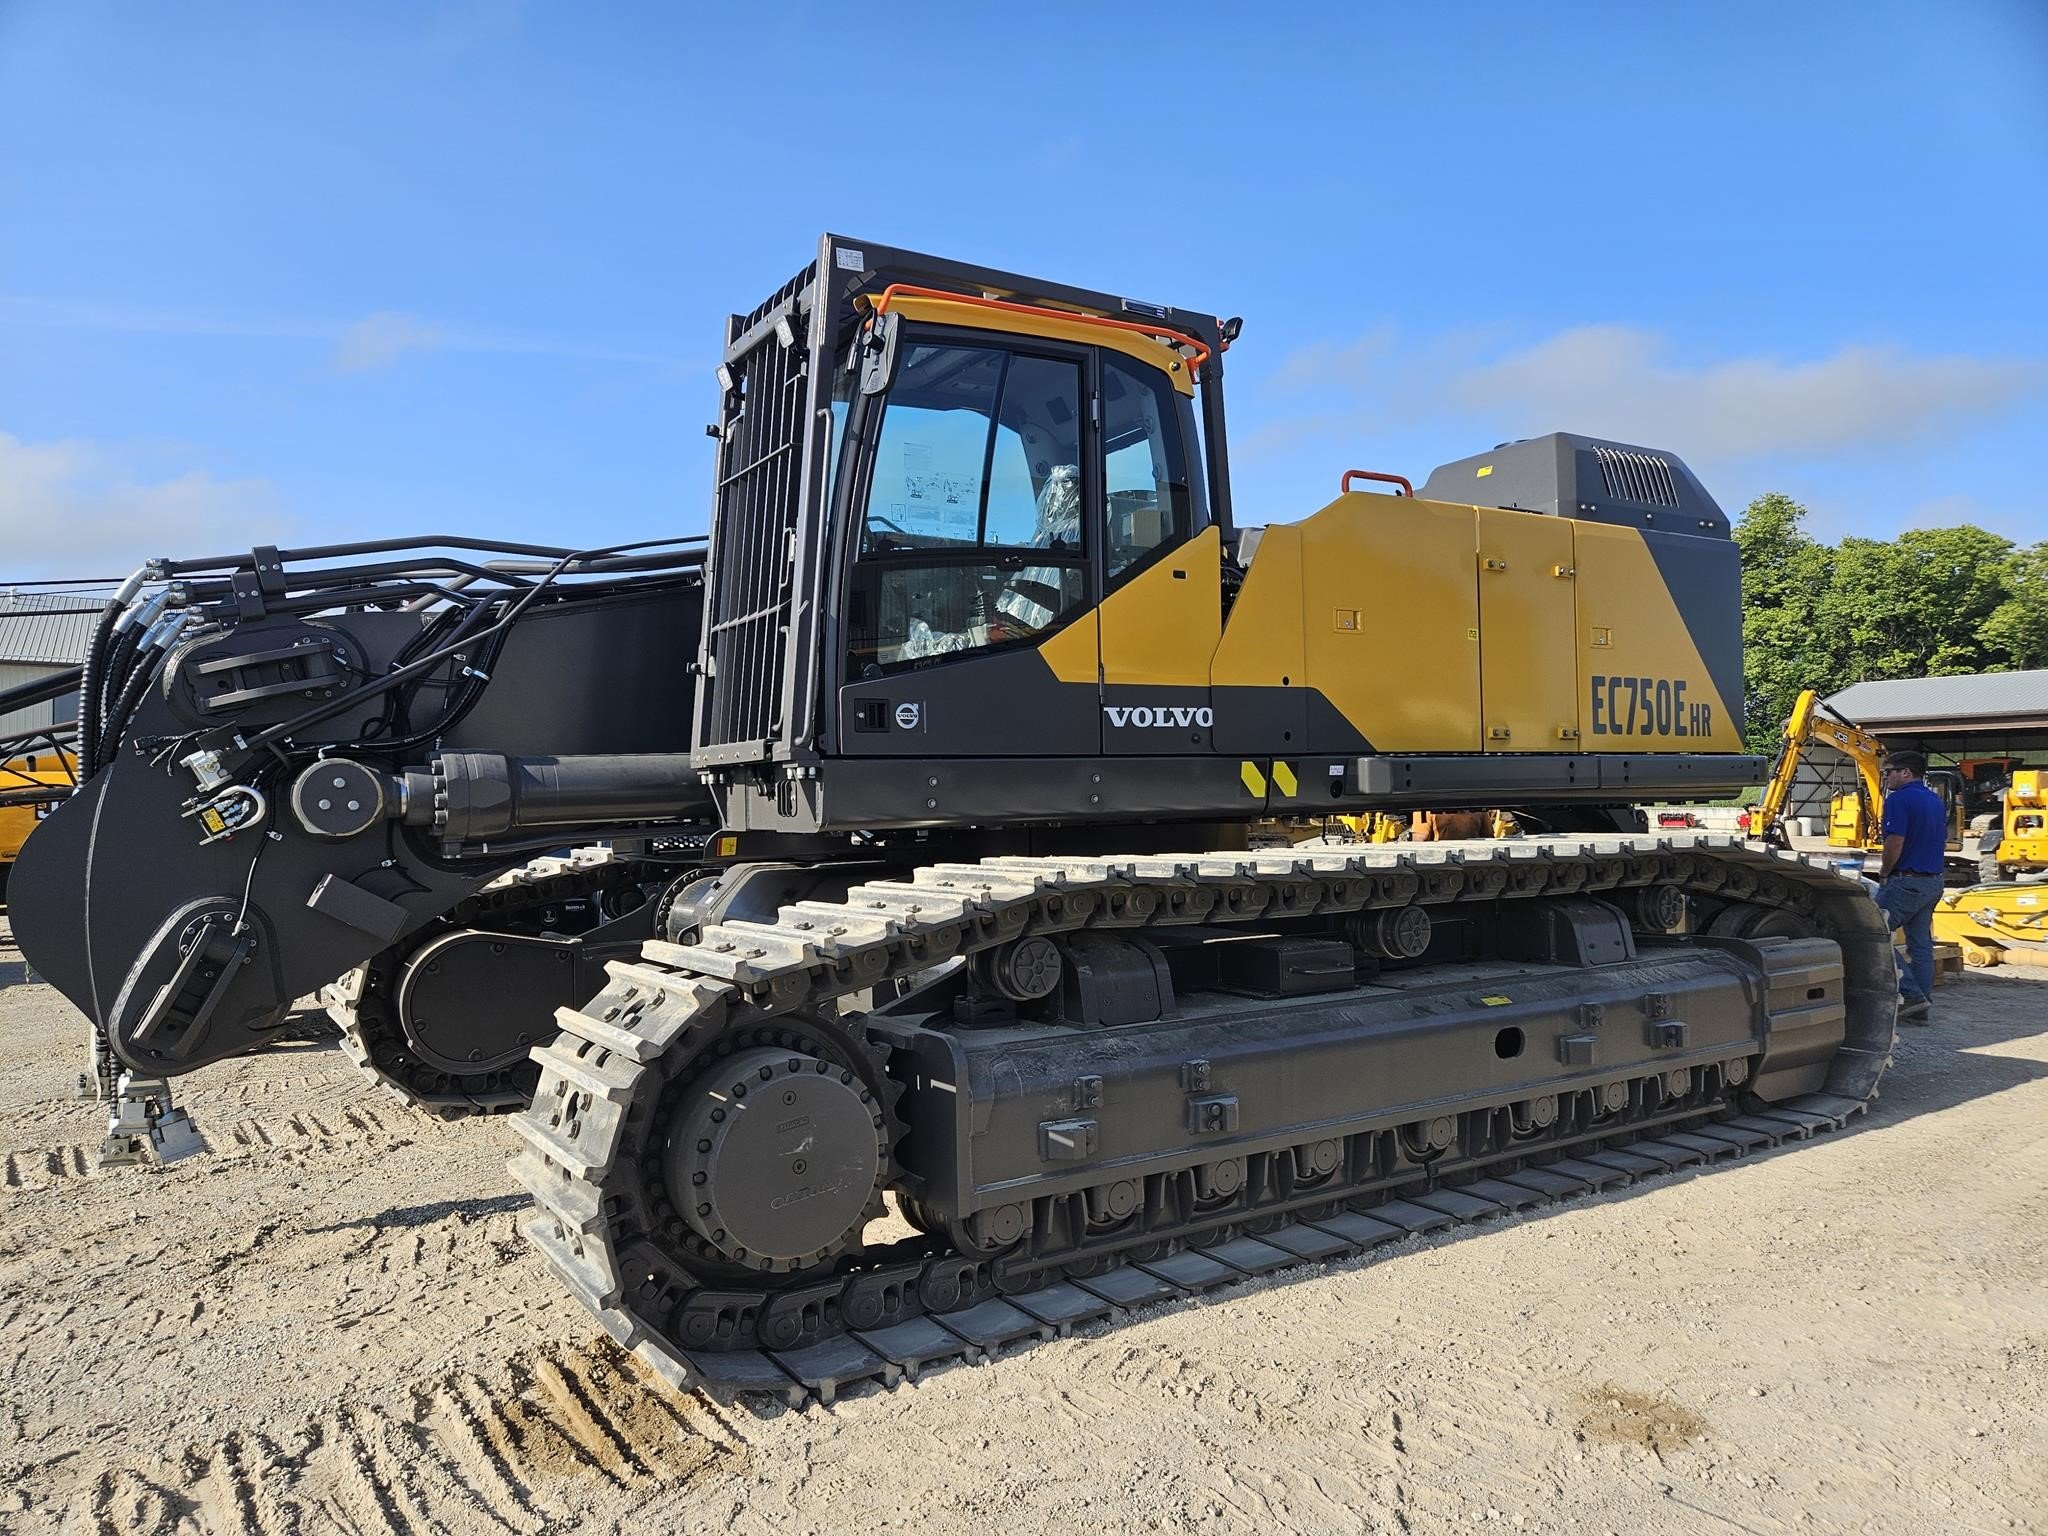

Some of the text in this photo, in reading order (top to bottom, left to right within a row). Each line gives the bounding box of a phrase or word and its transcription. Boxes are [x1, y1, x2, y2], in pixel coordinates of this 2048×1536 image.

[1103, 706, 1214, 728] VOLVO
[1591, 675, 1688, 737] EC750E
[1833, 731, 1848, 744] JCB
